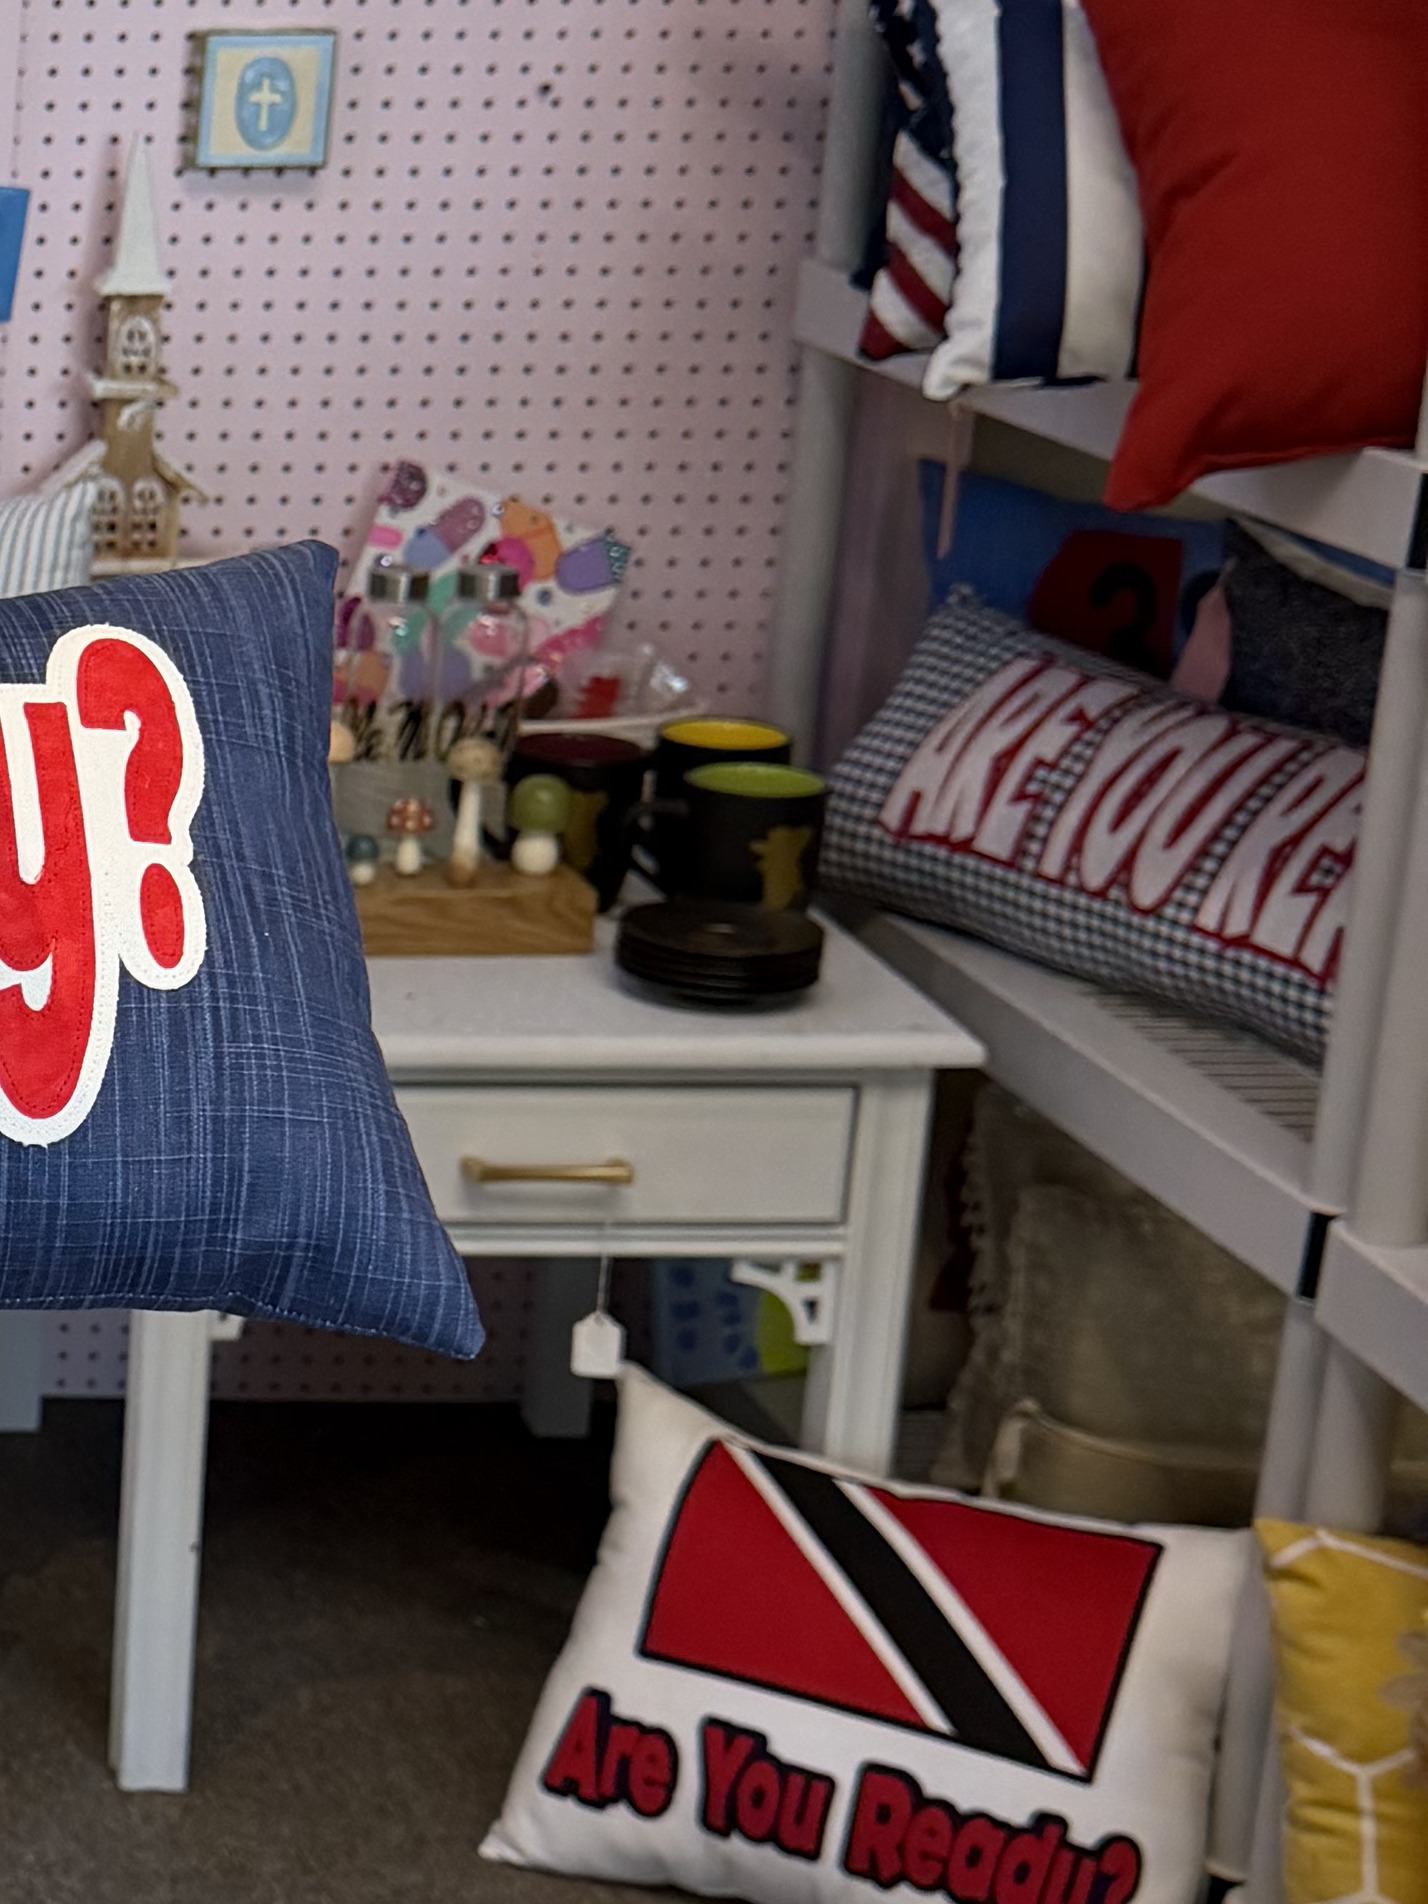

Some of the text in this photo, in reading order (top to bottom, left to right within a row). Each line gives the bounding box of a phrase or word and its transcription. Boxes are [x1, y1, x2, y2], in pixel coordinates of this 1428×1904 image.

[879, 656, 1368, 988] ARE YOU RE
[542, 1686, 677, 1819] Are
[696, 1715, 835, 1859] You
